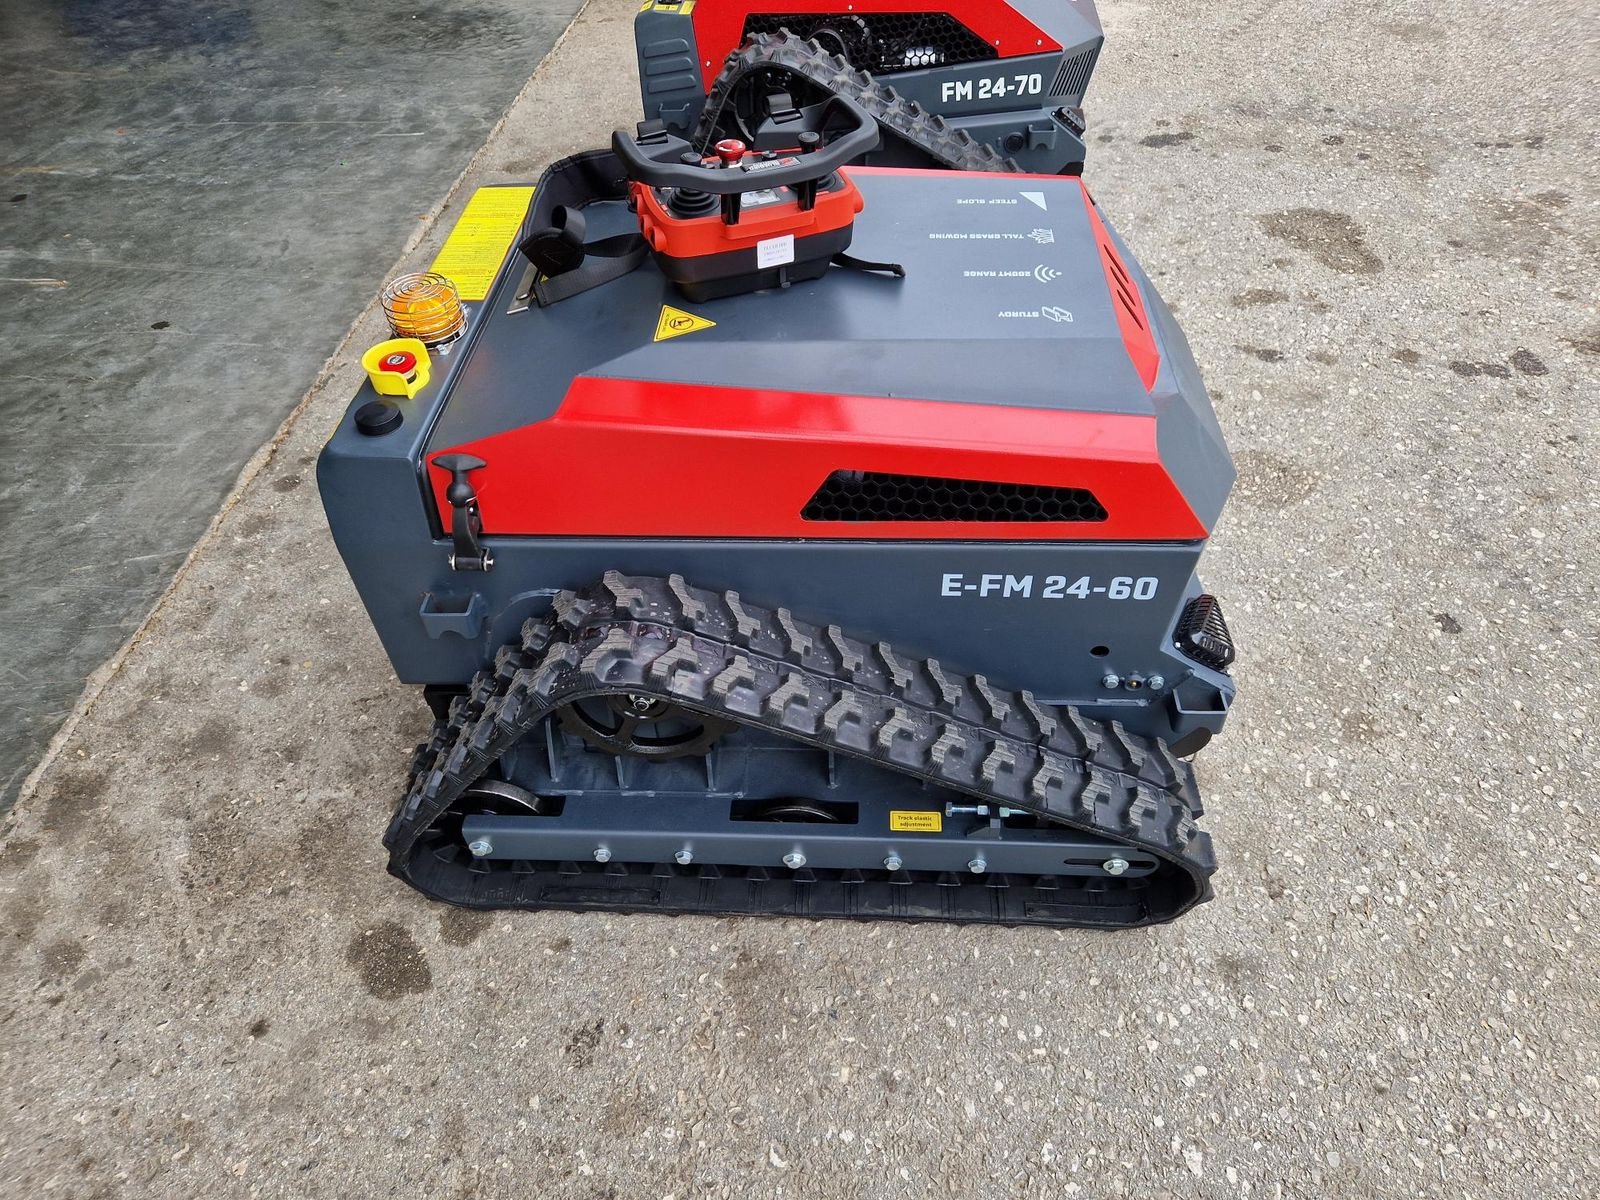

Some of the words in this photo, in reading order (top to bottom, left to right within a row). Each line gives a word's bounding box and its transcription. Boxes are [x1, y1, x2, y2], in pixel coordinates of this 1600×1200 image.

[942, 80, 973, 103] FM
[978, 73, 1042, 99] 24-70
[941, 573, 1034, 599] E-FM
[1042, 575, 1159, 601] 24-60
